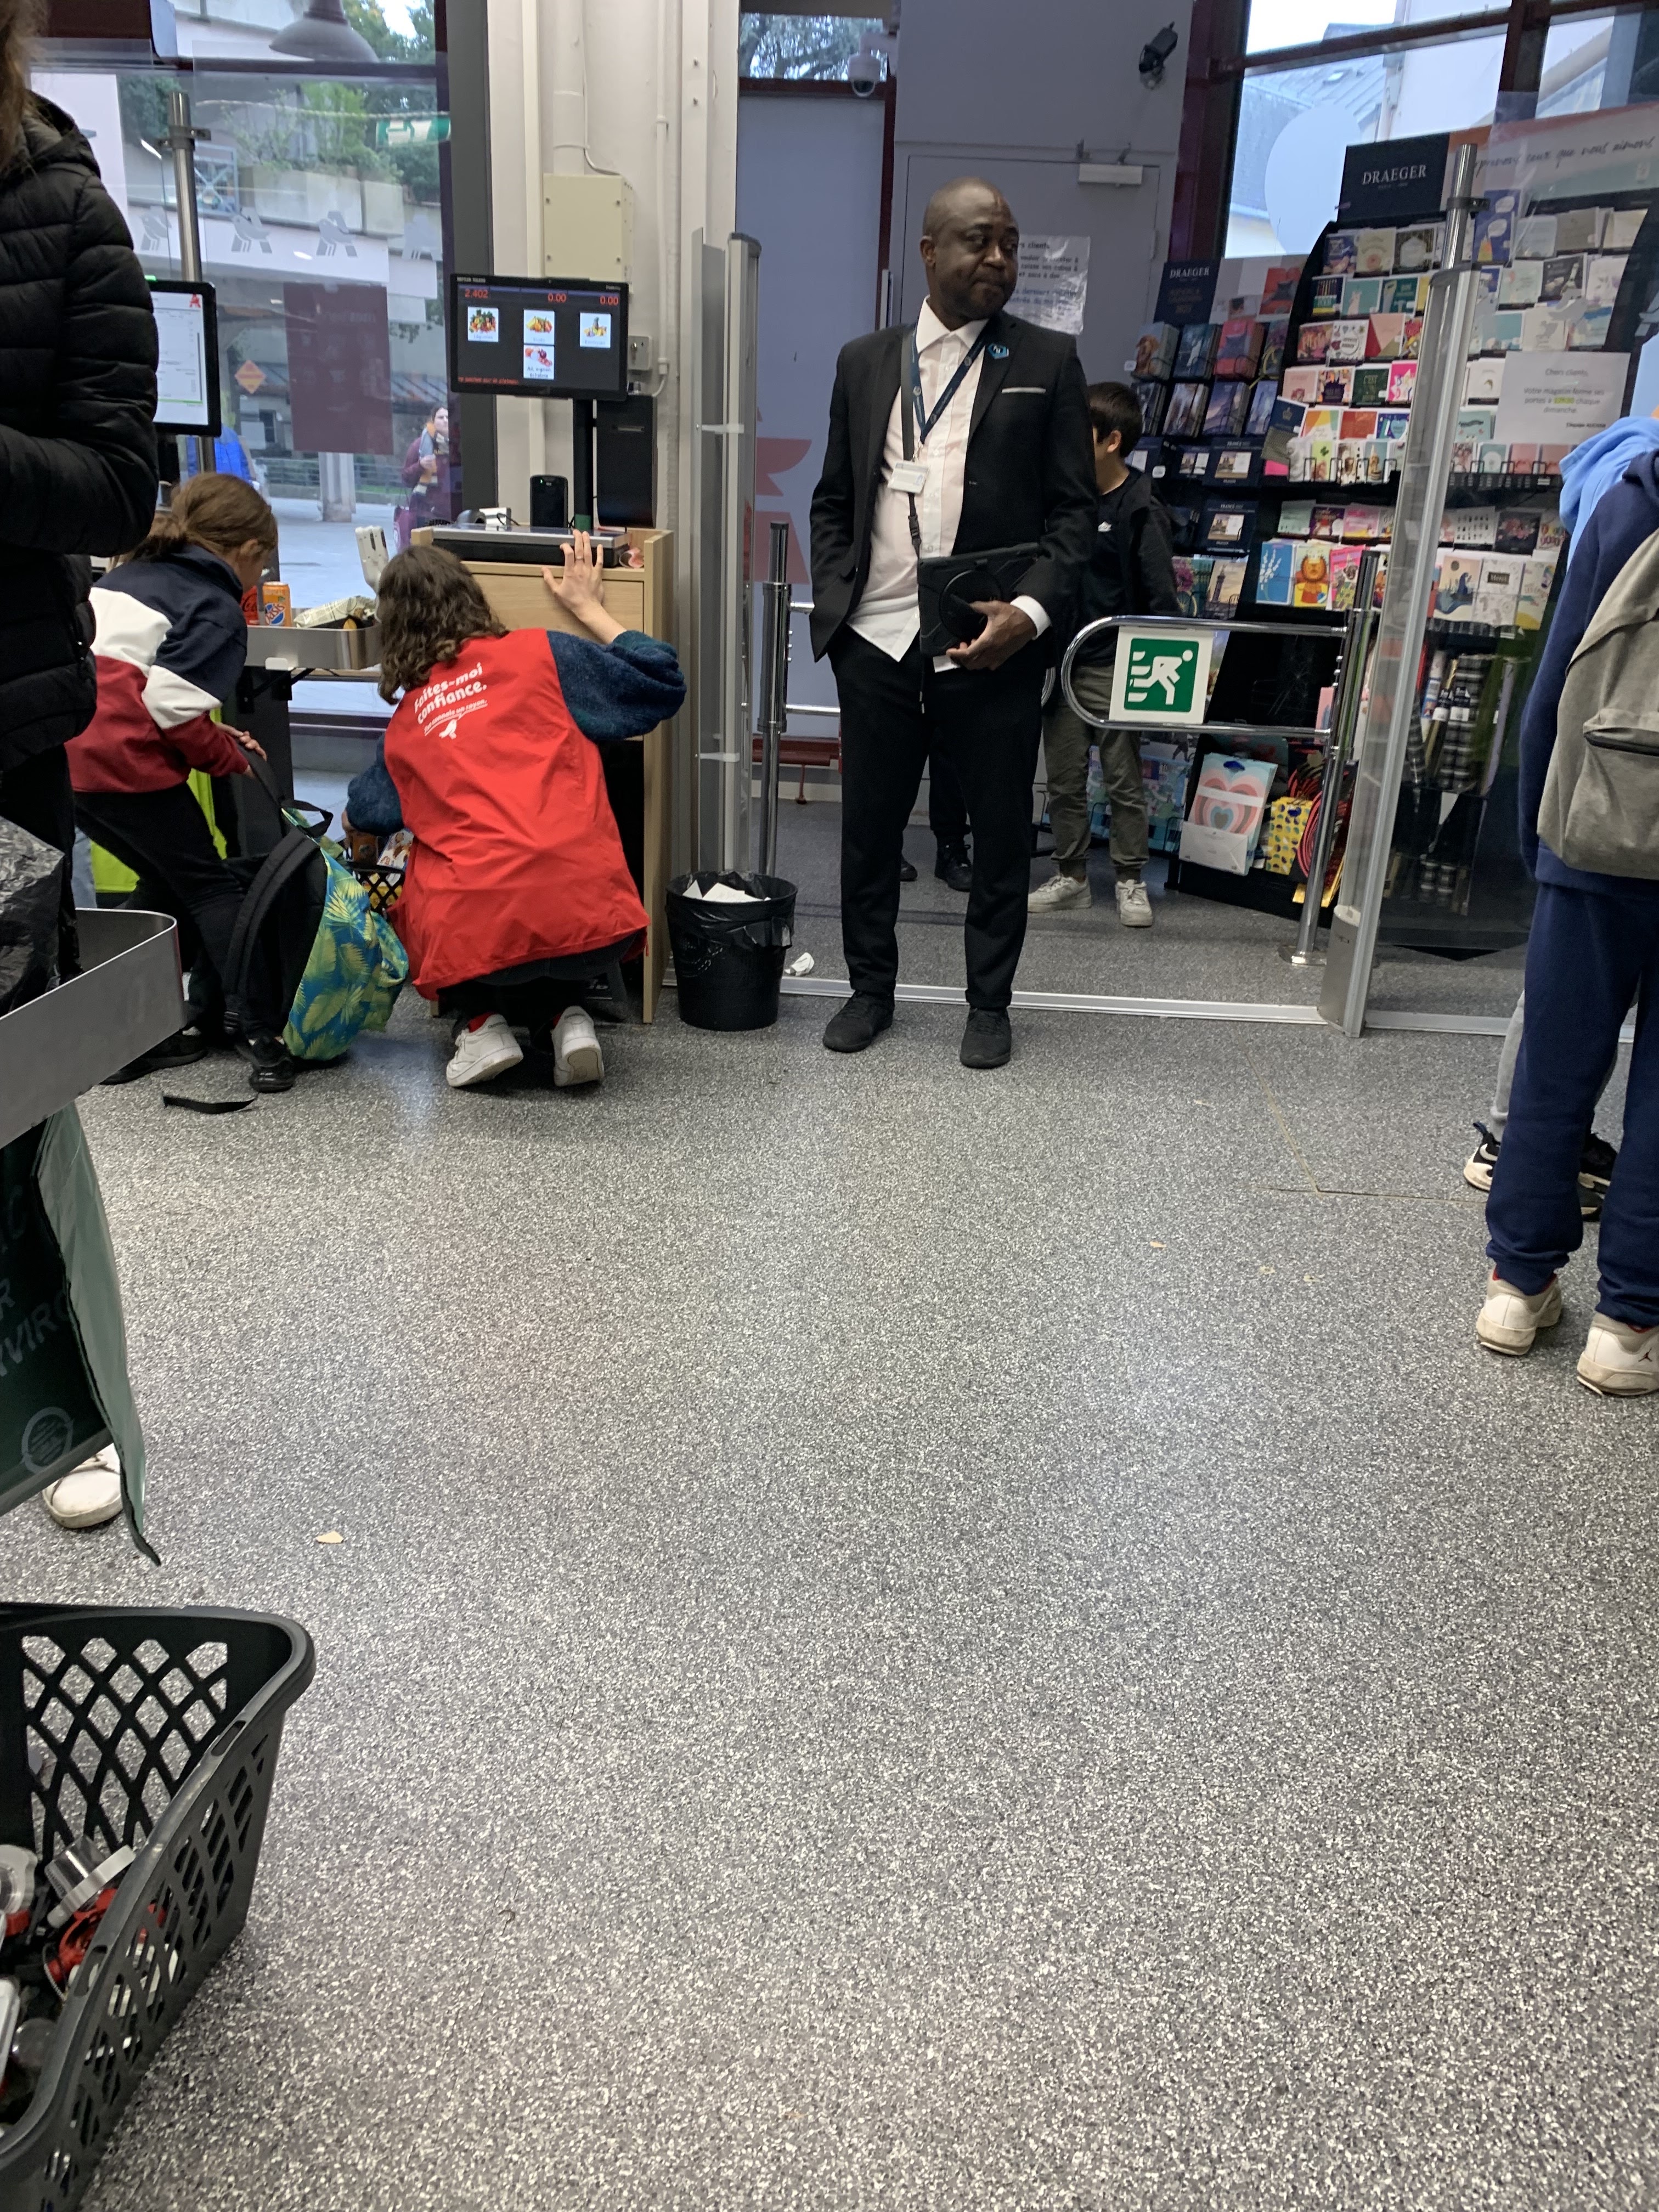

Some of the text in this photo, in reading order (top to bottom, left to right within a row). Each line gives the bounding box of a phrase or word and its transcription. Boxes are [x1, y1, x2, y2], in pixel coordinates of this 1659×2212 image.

[1555, 148, 1576, 169] que
[1581, 141, 1609, 156] nous
[1612, 136, 1656, 151] aimons
[1362, 164, 1427, 185] DRAEGER
[1169, 267, 1210, 279] DRAEGER
[465, 288, 488, 299] 2.402
[548, 292, 567, 303] 0.00
[600, 295, 619, 305] 0.00
[1543, 387, 1572, 396] magasin
[414, 662, 483, 714] Faites-moi
[417, 681, 488, 725] confiance.
[455, 706, 465, 714] un
